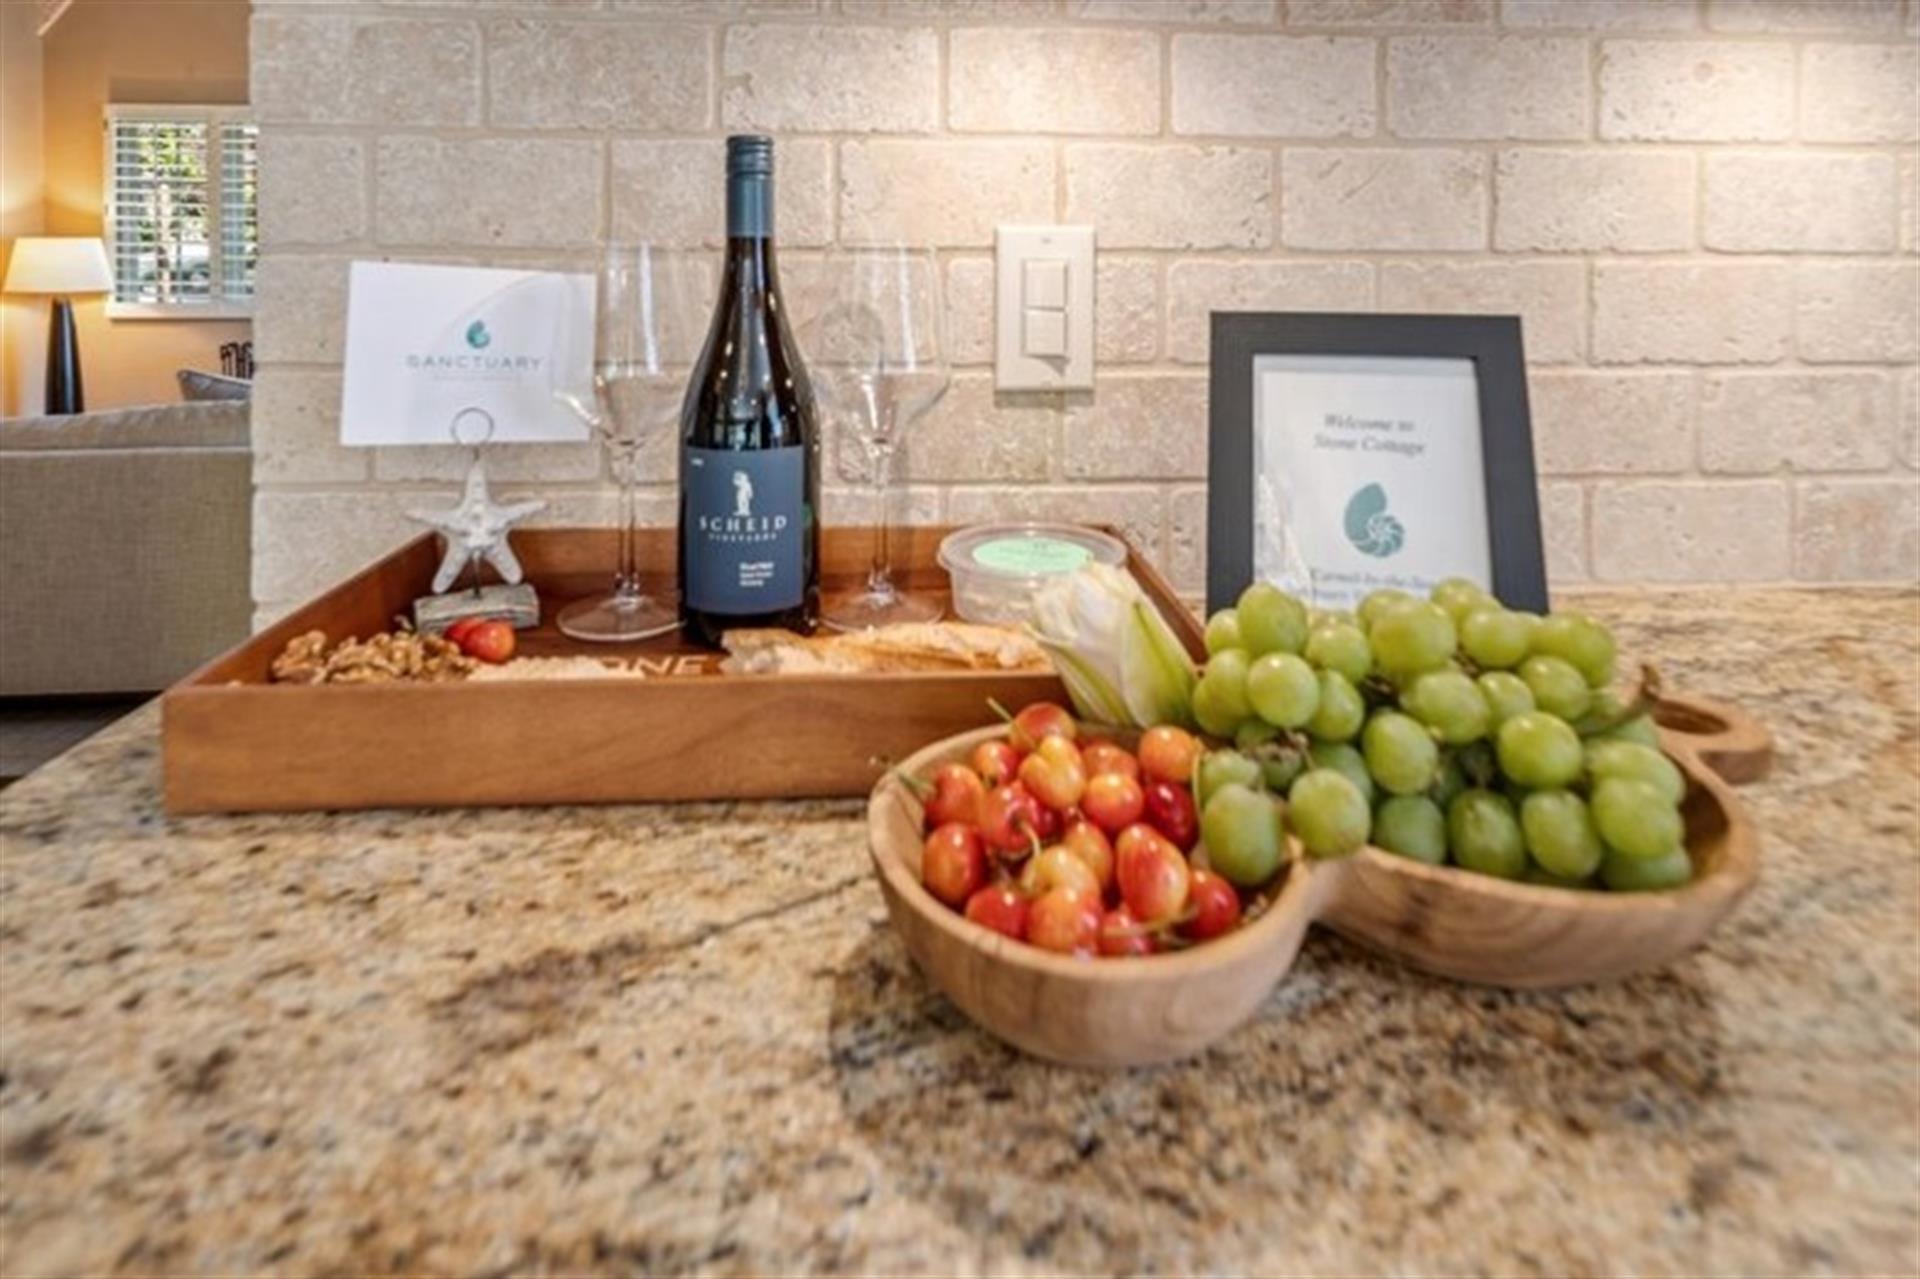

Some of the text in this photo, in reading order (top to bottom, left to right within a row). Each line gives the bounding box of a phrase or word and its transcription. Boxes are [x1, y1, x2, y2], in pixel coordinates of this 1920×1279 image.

[406, 354, 542, 369] SANCTUARY
[1324, 413, 1415, 432] Welcome to
[1314, 433, 1426, 458] Stone Cottage
[699, 515, 787, 532] SCHEID
